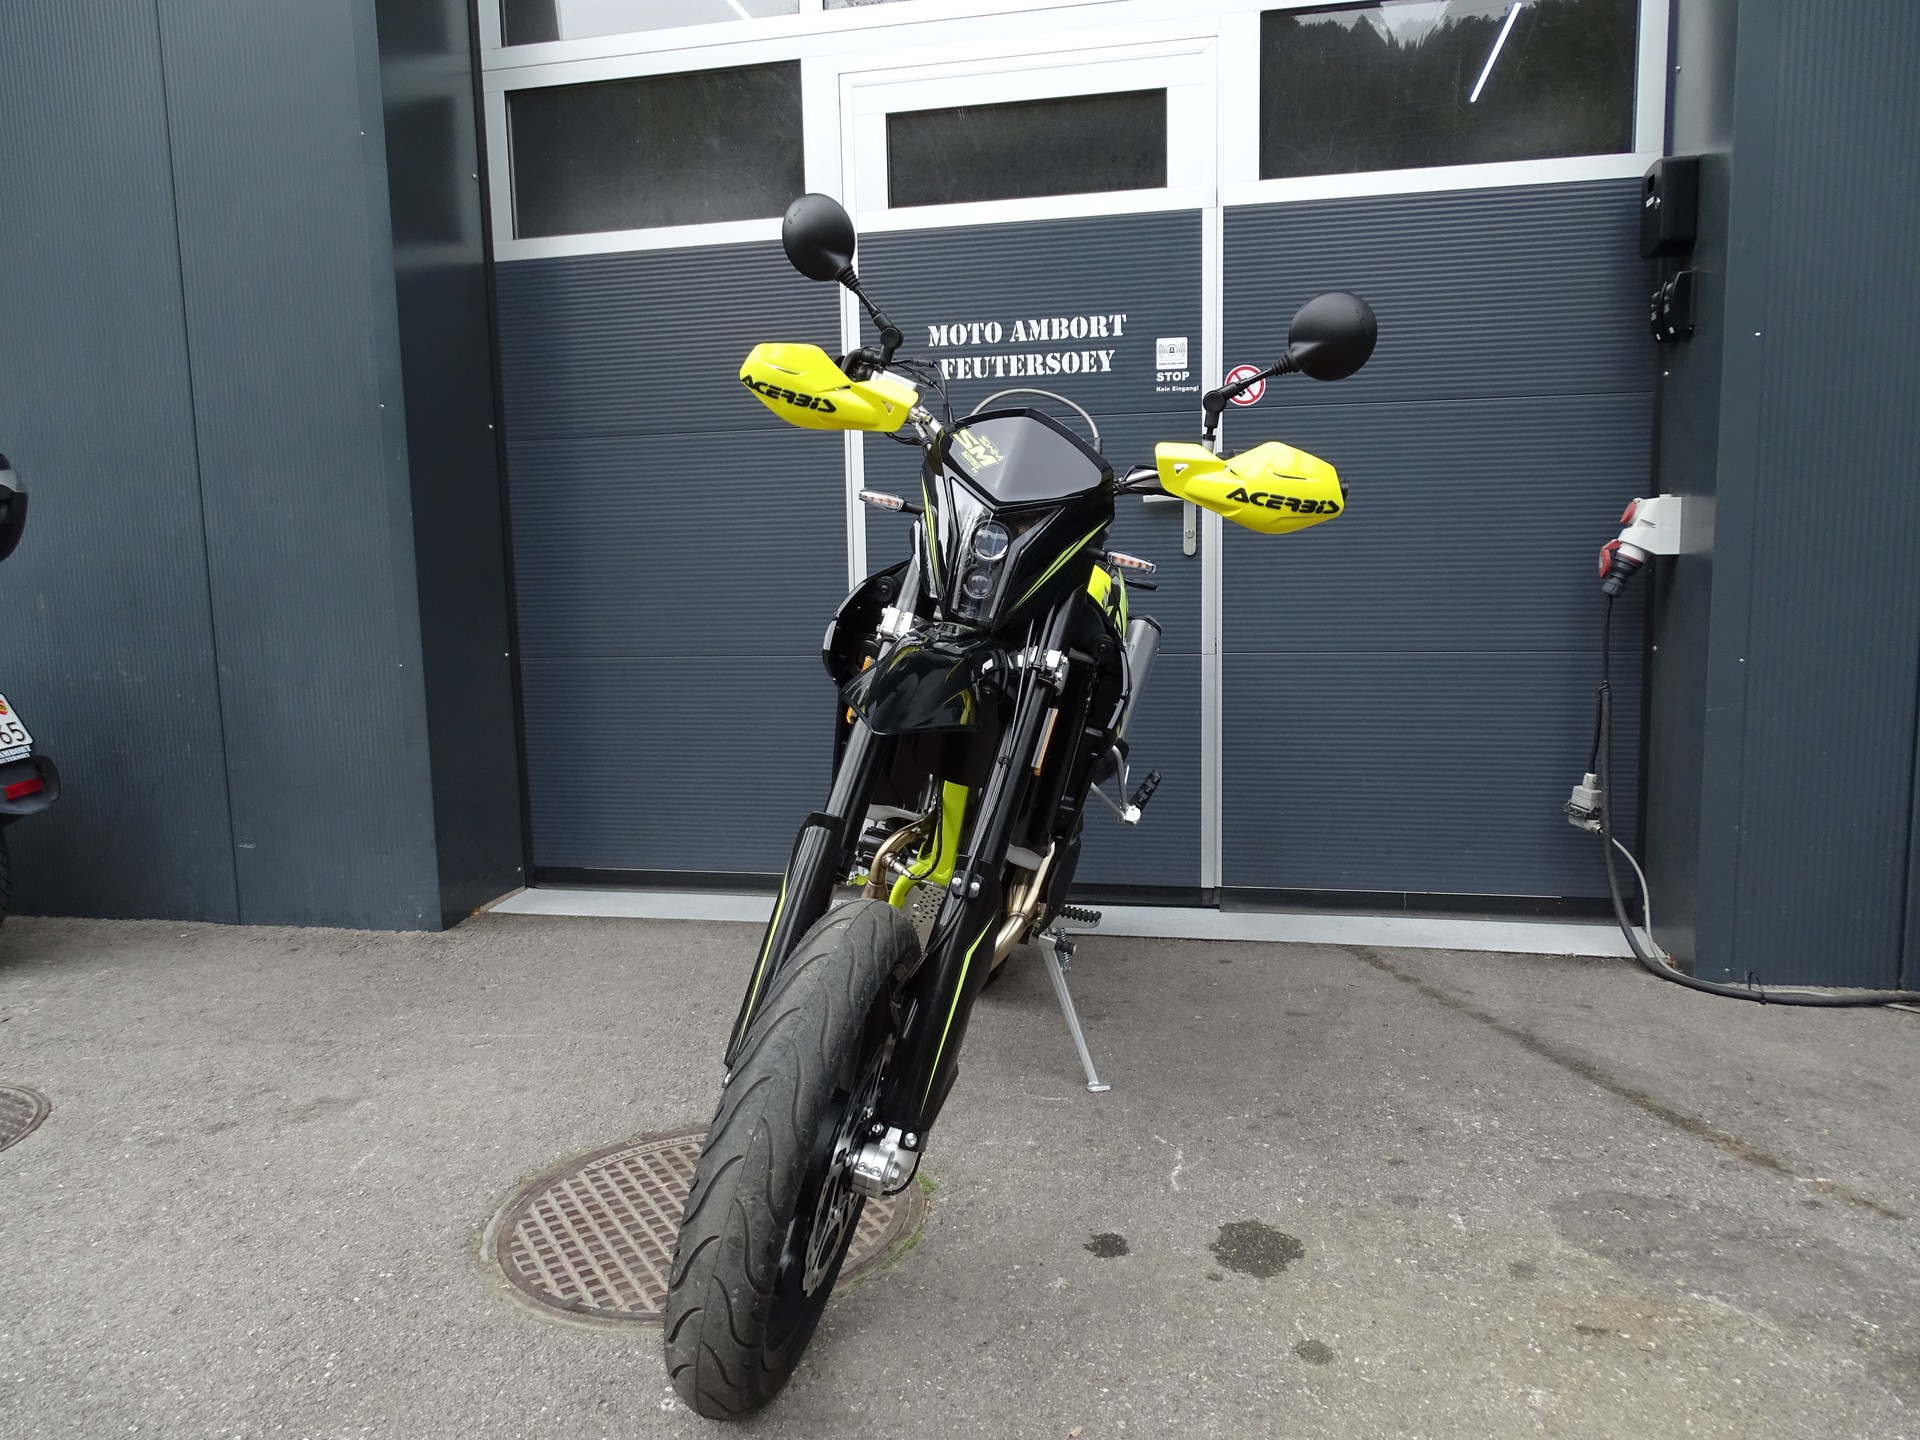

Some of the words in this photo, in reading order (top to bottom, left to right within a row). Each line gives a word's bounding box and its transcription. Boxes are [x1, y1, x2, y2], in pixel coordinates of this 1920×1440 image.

[928, 320, 1003, 347] MOTO
[1009, 314, 1127, 343] AMBORT
[940, 349, 1116, 380] FEUTERSOEY
[1156, 371, 1190, 382] STOP
[952, 428, 998, 467] SM
[978, 435, 1004, 462] SWM
